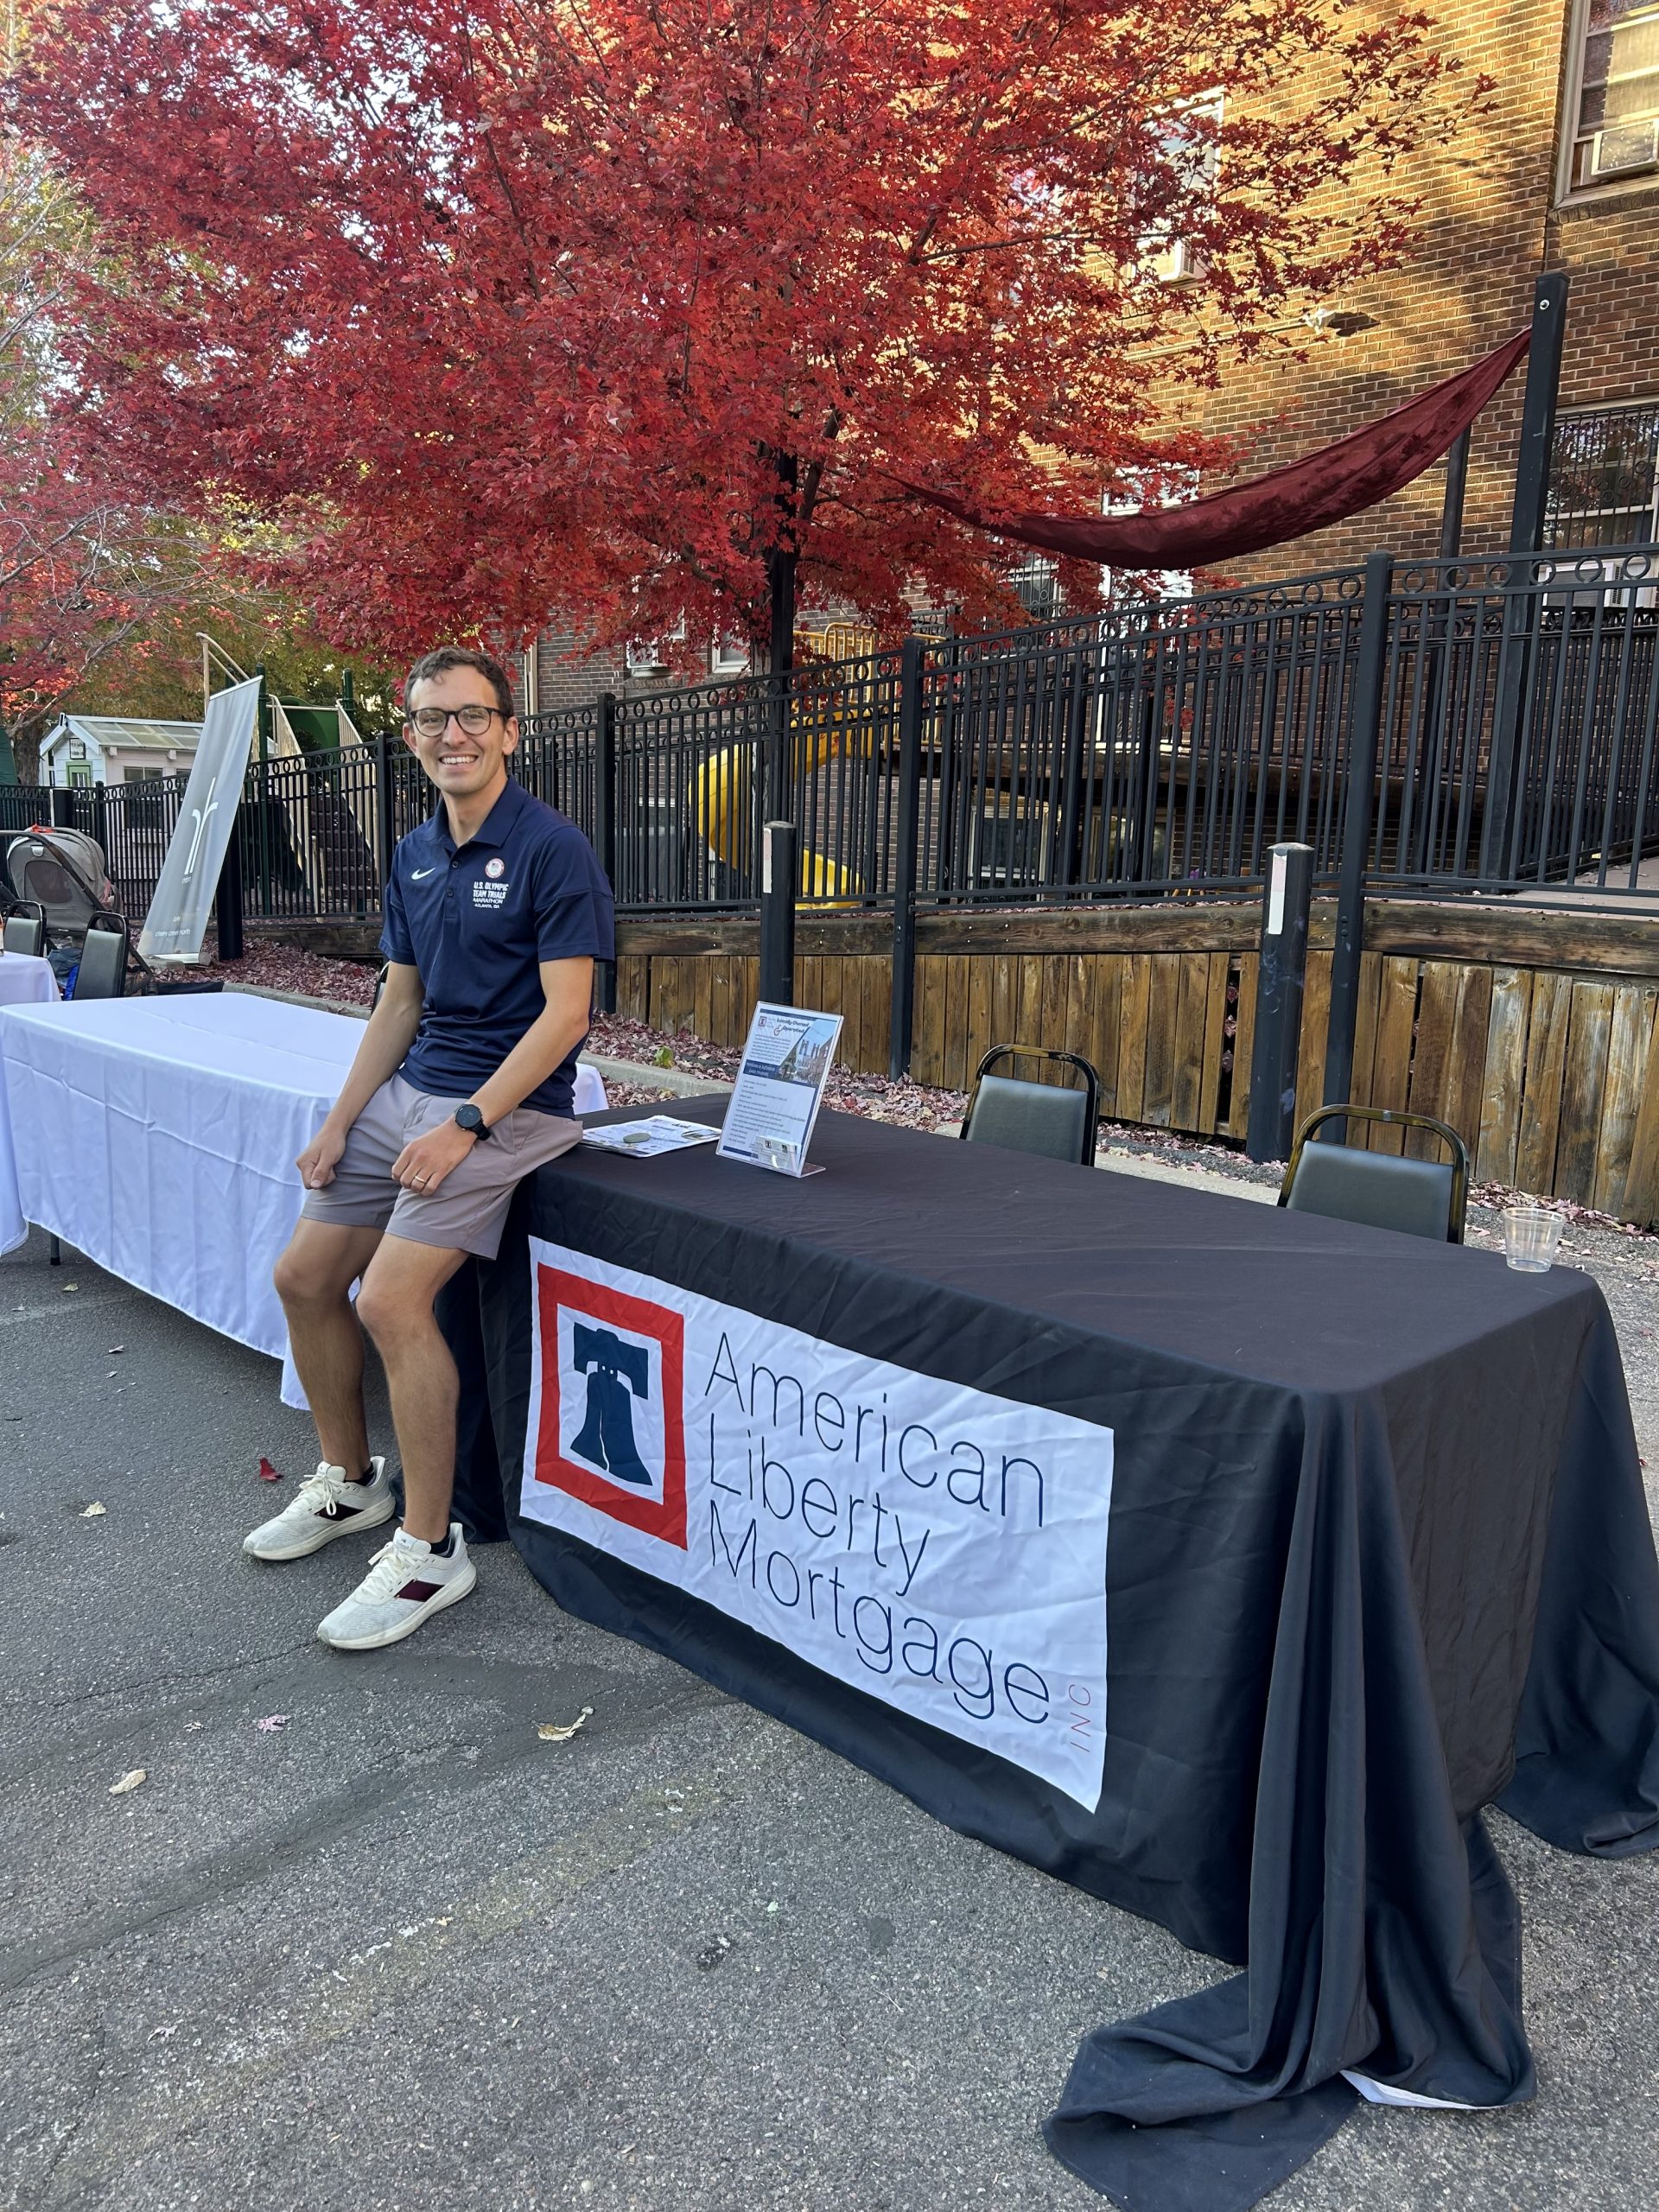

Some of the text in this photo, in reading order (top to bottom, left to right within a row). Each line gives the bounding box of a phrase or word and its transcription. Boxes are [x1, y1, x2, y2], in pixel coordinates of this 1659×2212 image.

[485, 882, 509, 891] OLYMPIC
[777, 1018, 792, 1027] Locally
[704, 1332, 1045, 1528] American
[709, 1413, 931, 1597] Liberty
[709, 1499, 1091, 1753] Mortgage INC
